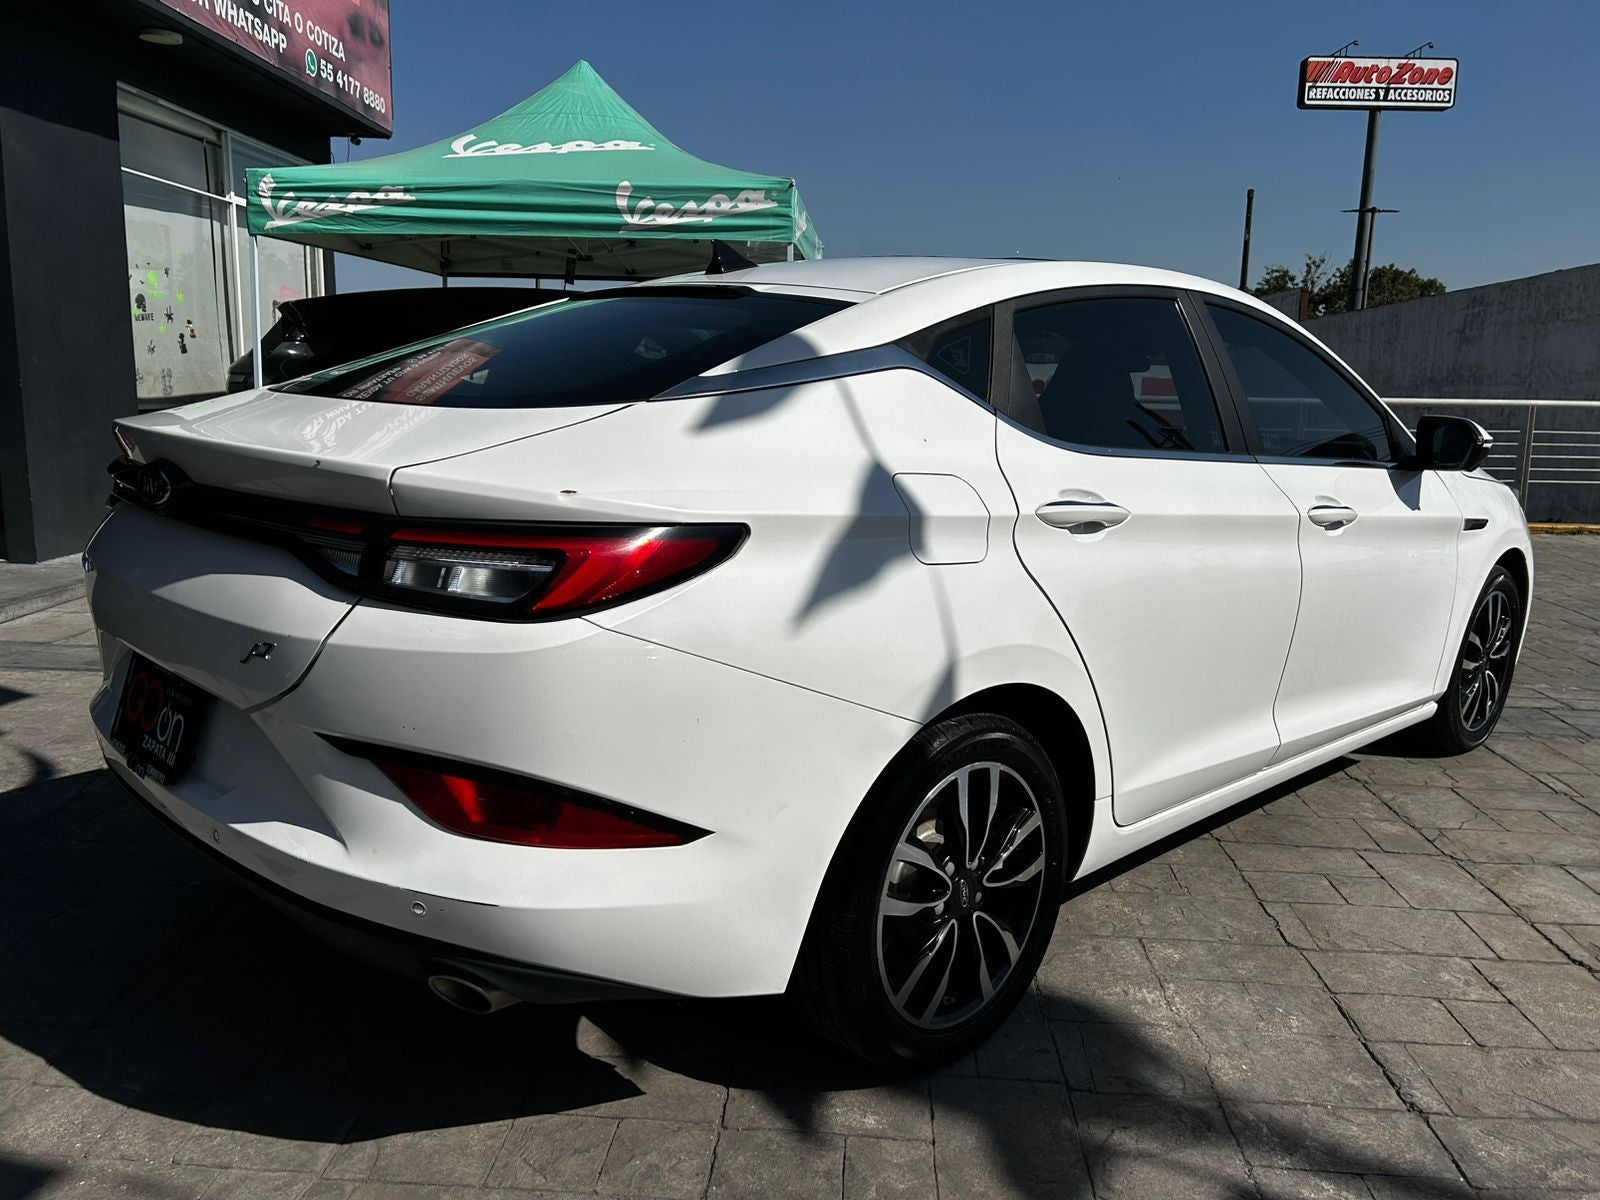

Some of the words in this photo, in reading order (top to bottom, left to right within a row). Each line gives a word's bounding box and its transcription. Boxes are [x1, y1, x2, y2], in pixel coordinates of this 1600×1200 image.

[213, 0, 288, 53] WHATSAPP
[264, 0, 293, 27] CITA
[295, 18, 303, 33] O
[306, 21, 346, 62] COTIZA
[320, 59, 334, 83] 55
[336, 73, 361, 98] 4177
[363, 87, 386, 114] 8880
[1308, 87, 1376, 100] REFACCIONES
[1378, 89, 1385, 101] Y
[1387, 89, 1450, 102] ACCESORIOS
[1329, 61, 1454, 86] AutoZone
[442, 134, 656, 158] Vespa
[258, 173, 417, 230] Vespa
[616, 180, 778, 233] Vespa
[142, 734, 167, 760] ZAPATA
